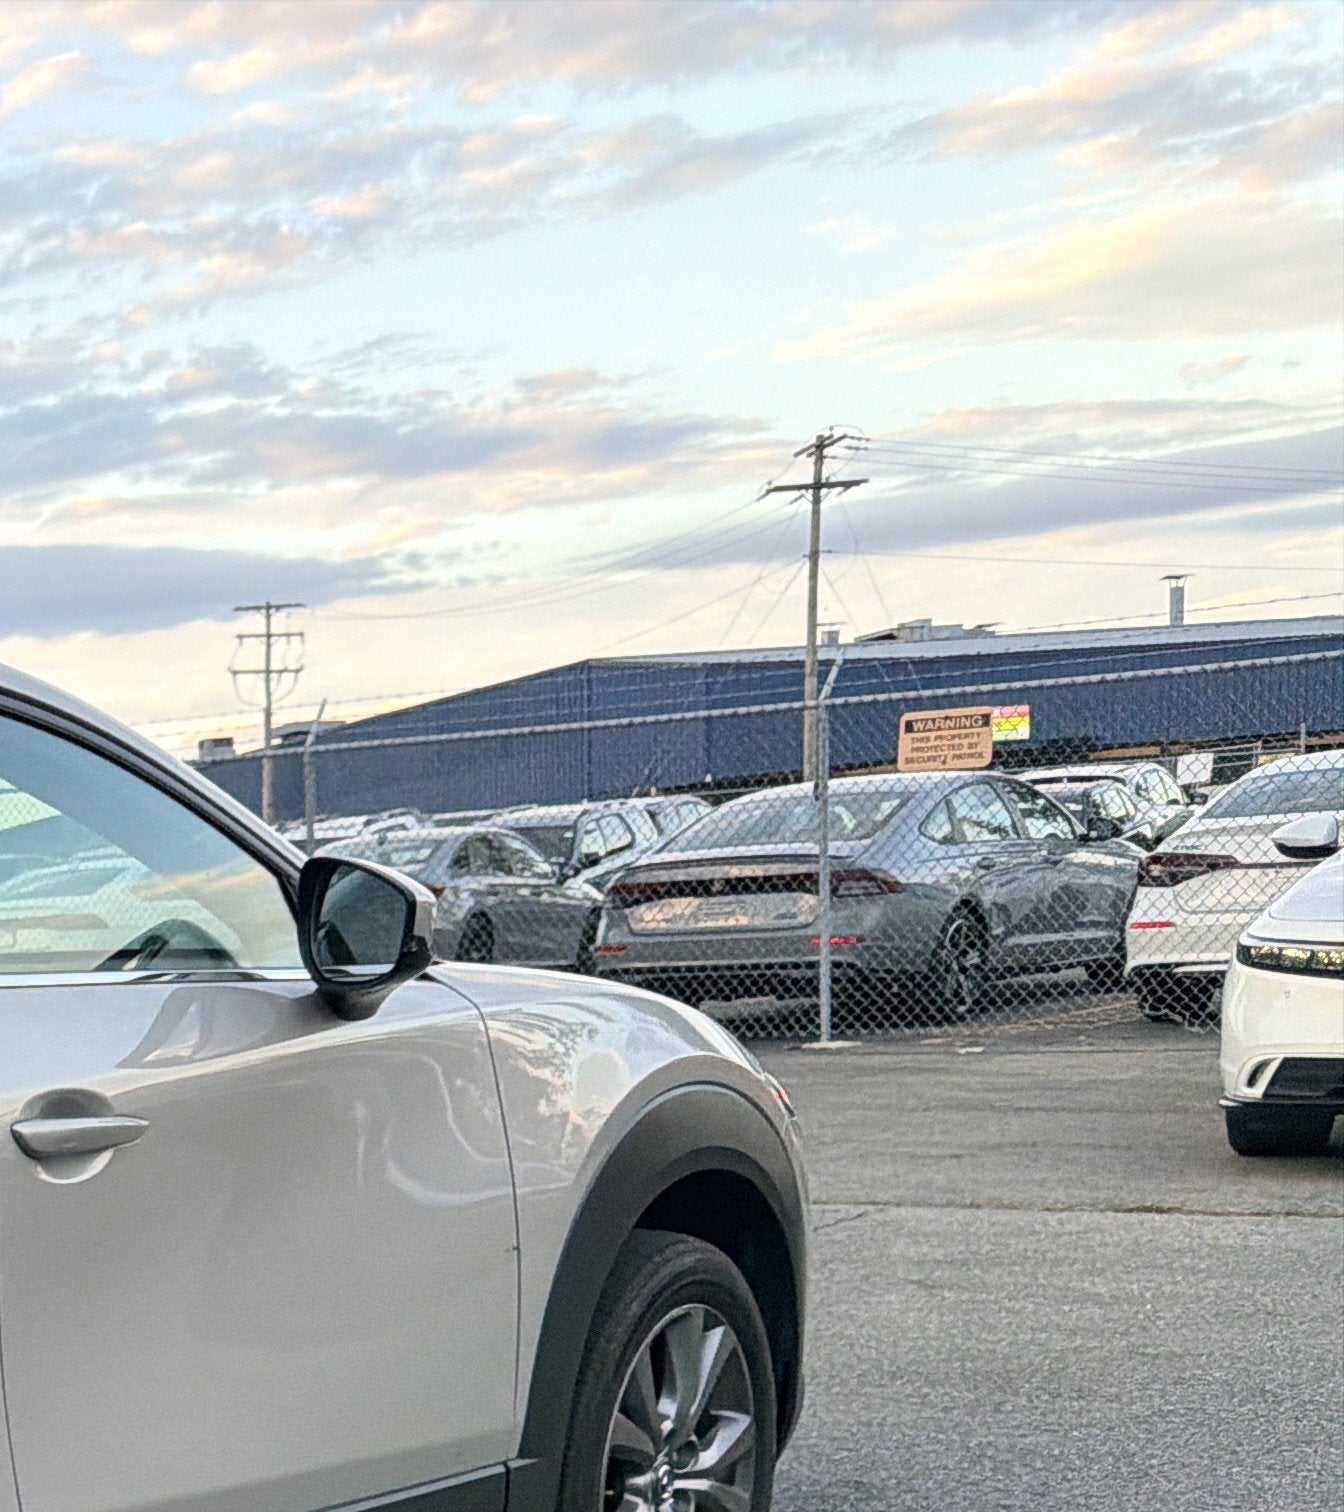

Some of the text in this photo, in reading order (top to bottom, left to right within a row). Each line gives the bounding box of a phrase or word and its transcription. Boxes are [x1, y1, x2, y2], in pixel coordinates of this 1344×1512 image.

[912, 715, 984, 732] WARNING
[912, 732, 981, 744] THIS PROPERTY
[911, 741, 979, 754] PROTECTED BY
[952, 752, 985, 761] PATROL
